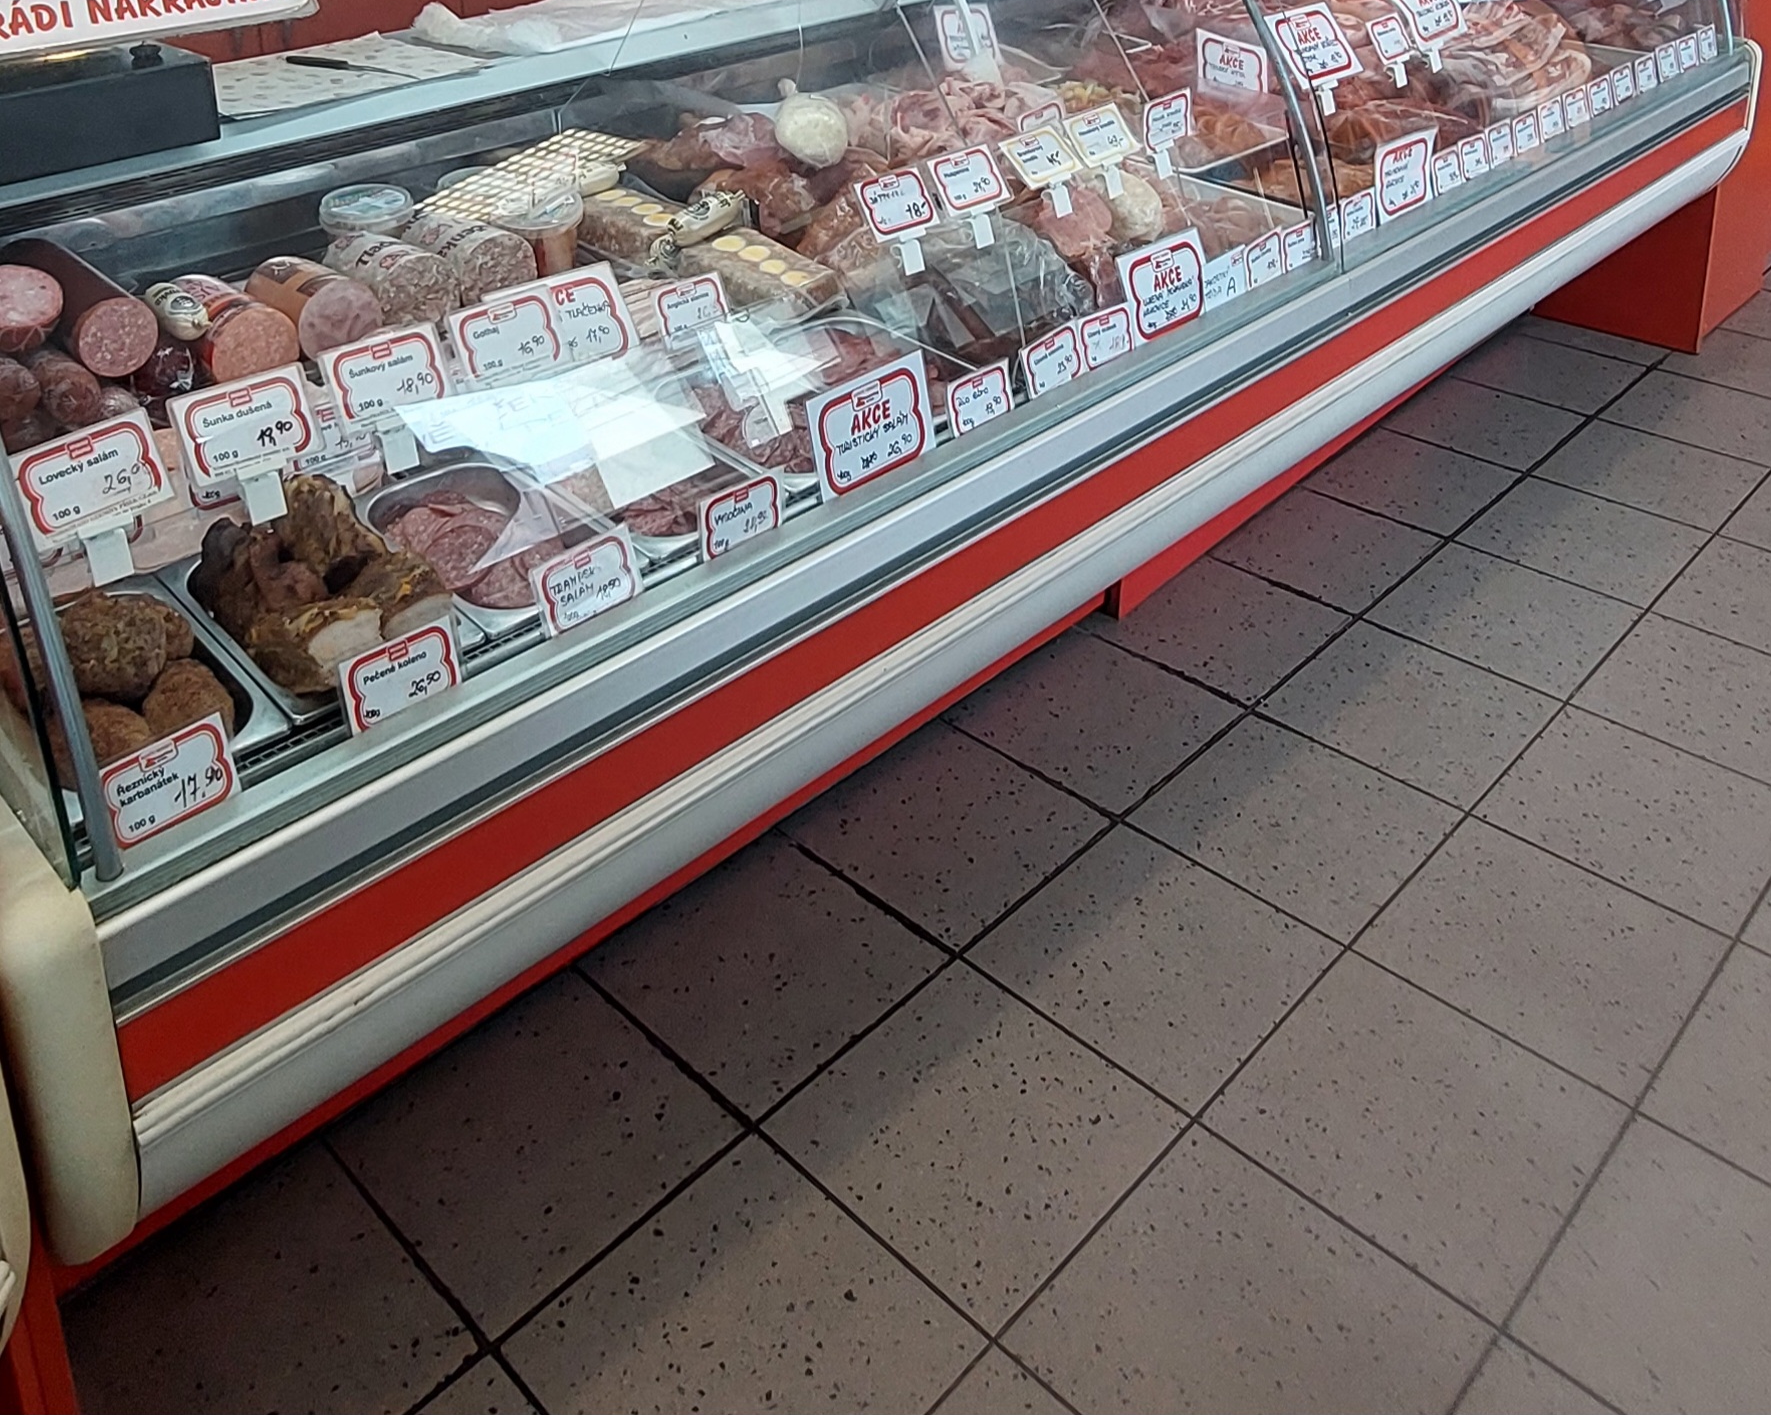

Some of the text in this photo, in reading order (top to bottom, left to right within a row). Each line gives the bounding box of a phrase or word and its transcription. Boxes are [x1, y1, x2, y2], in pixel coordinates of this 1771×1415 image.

[1297, 26, 1322, 46] AKCE
[1219, 53, 1245, 71] AKCE
[1153, 265, 1182, 293] AKCE
[555, 287, 577, 307] CE
[348, 354, 414, 380] Šunkový salám
[396, 371, 434, 396] 18,90
[201, 400, 273, 429] Šunka dušená
[358, 399, 376, 412] 100
[850, 398, 891, 437] AKCE
[37, 448, 120, 486] Lovecký salám
[212, 449, 240, 464] 100 g
[52, 504, 81, 521] 100 g
[362, 650, 428, 685] Pečené koleno
[116, 766, 166, 797] Řeznický
[119, 771, 180, 808] karbanátek
[128, 814, 156, 833] 100 g
